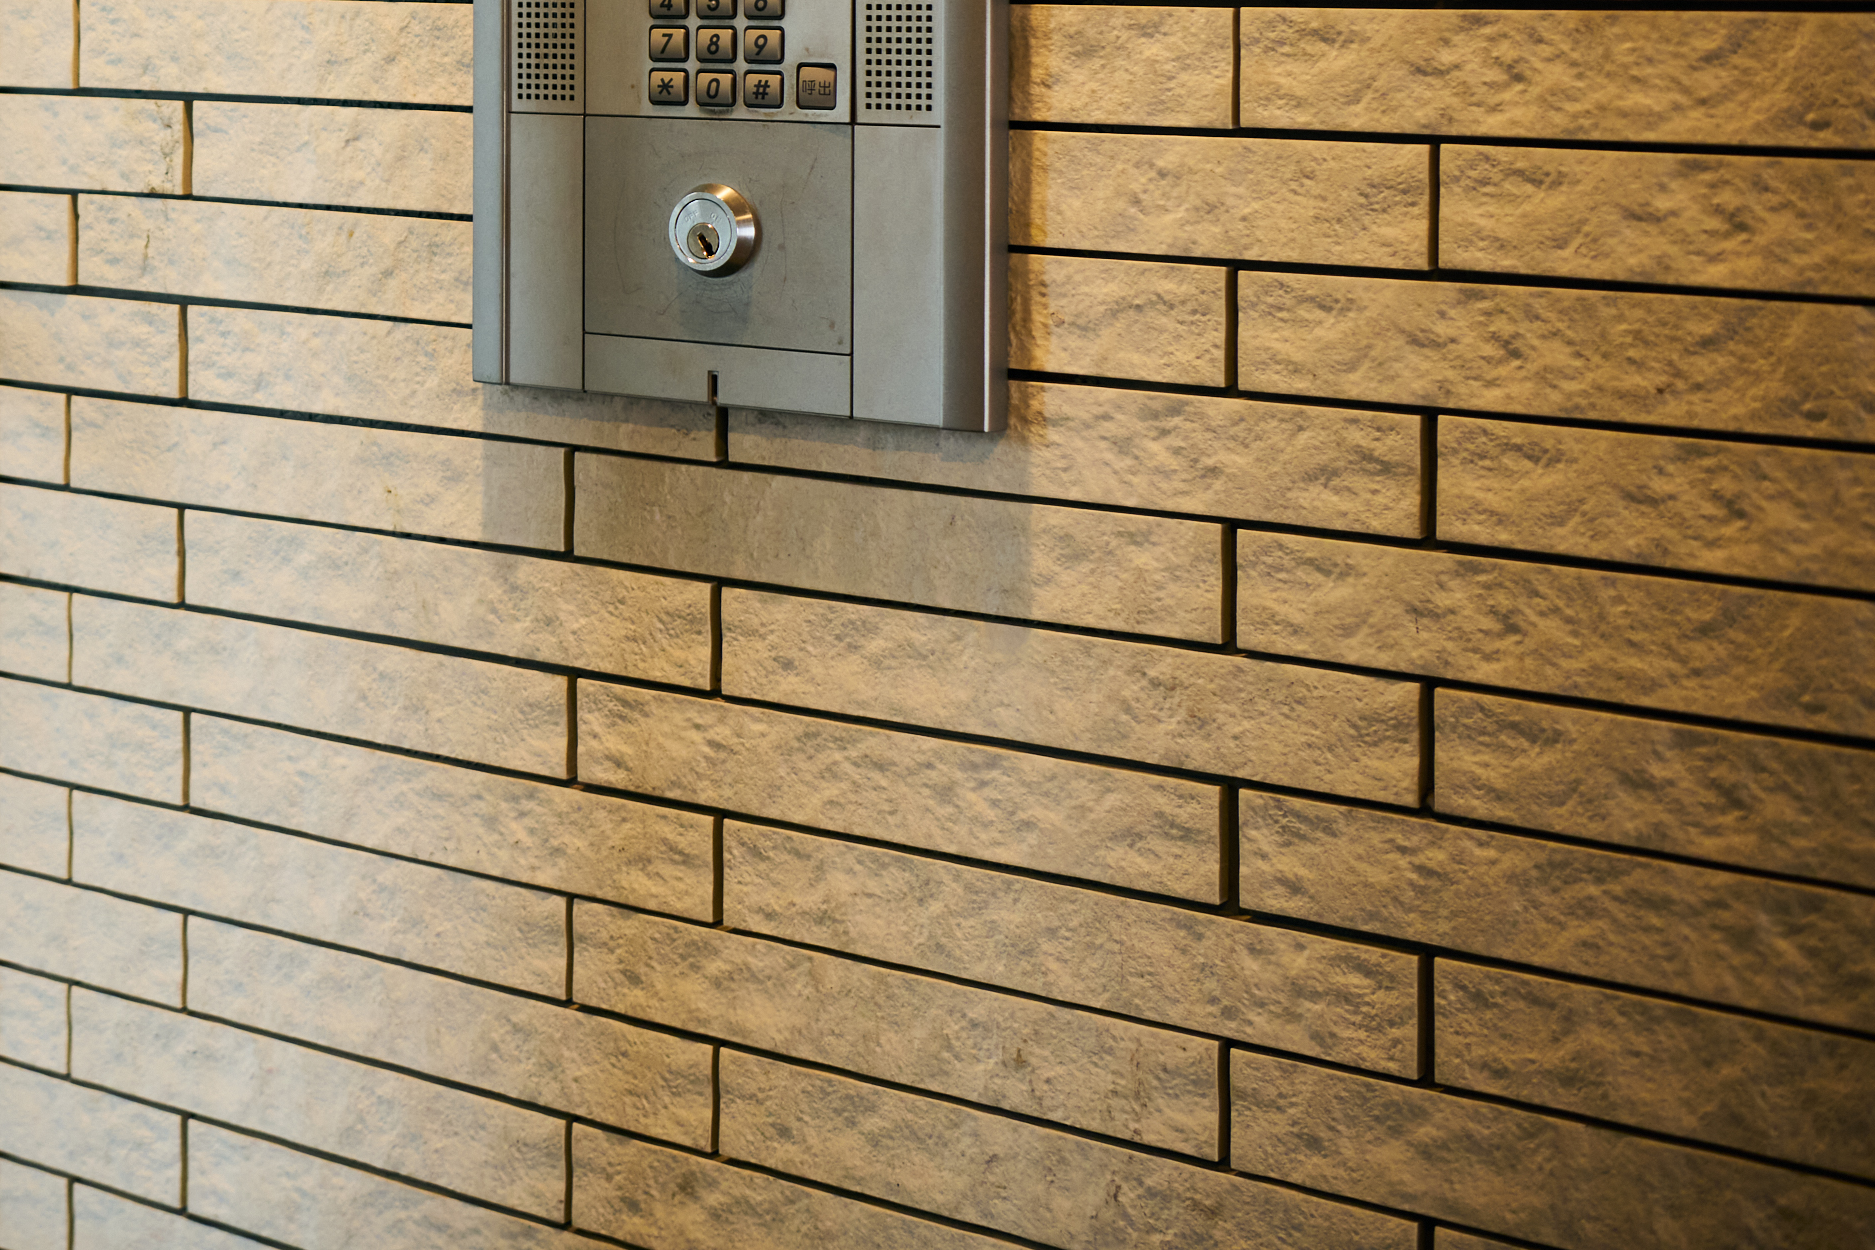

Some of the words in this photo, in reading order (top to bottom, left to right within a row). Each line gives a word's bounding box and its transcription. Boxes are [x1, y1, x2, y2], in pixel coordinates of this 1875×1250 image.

[660, 33, 673, 54] 7
[706, 33, 721, 55] 8
[754, 34, 768, 56] 9
[706, 78, 720, 99] 0
[752, 79, 771, 100] #
[802, 80, 831, 96] 呼出
